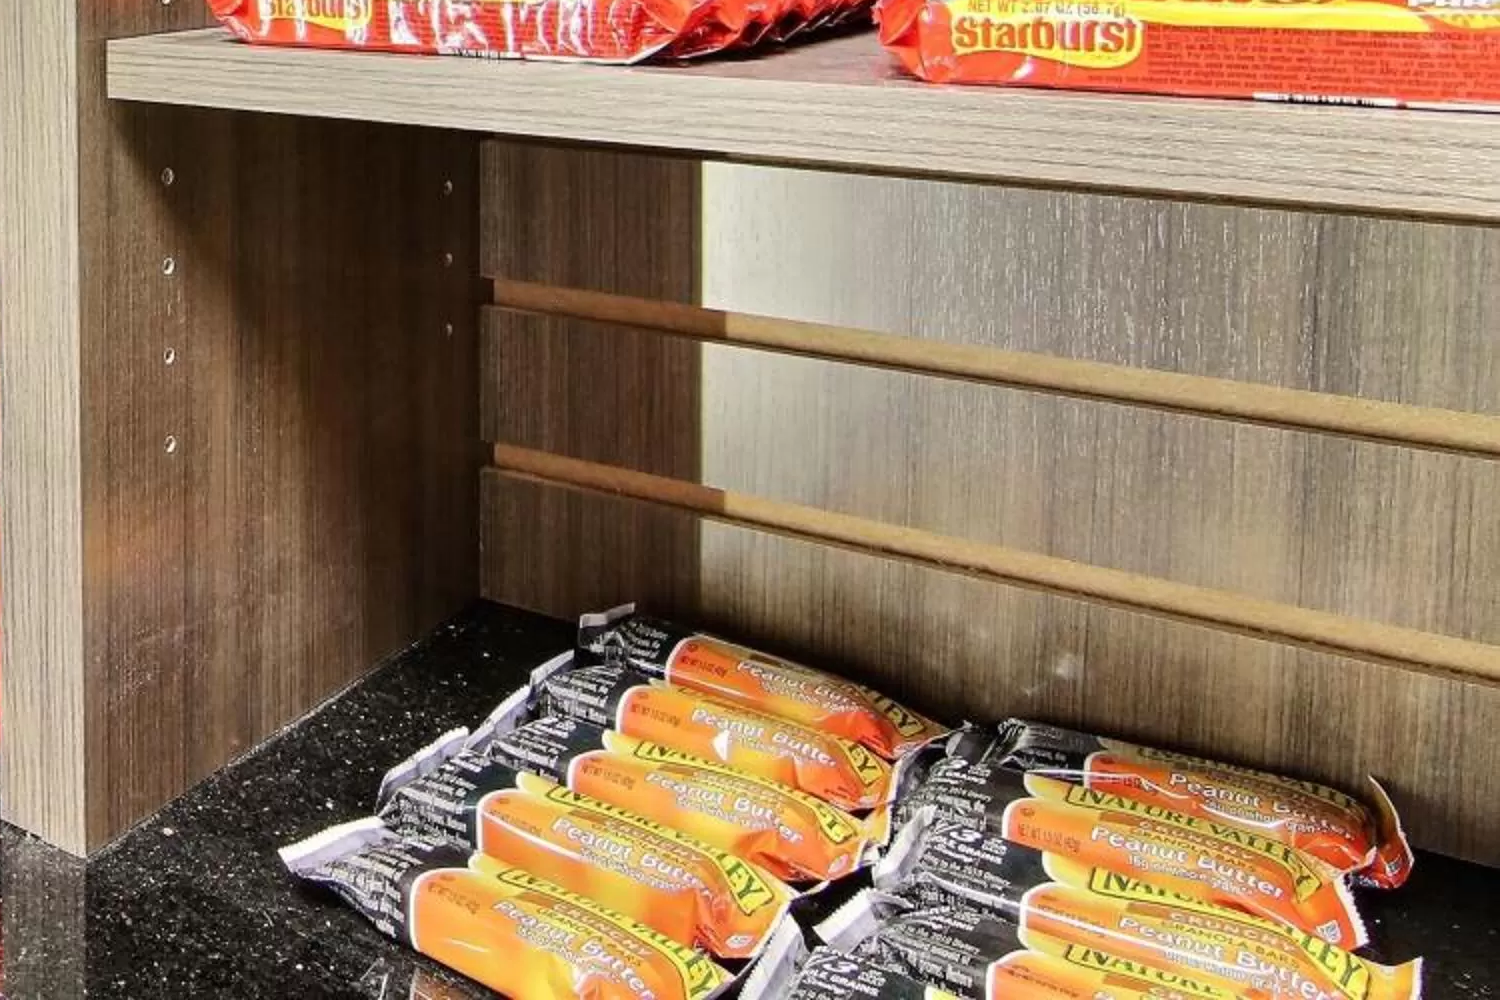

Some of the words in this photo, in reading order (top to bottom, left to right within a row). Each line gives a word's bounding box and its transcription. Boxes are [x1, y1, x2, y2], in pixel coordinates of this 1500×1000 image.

[968, 0, 992, 13] NET
[954, 16, 1137, 53] Starburst
[645, 772, 724, 805] Peanut
[1169, 773, 1259, 808] Peanut
[552, 816, 633, 859] Peanut
[1091, 824, 1188, 864] Peanut
[1198, 850, 1285, 900] Butter
[493, 900, 578, 946] Peanut
[1119, 917, 1225, 960] Peanut
